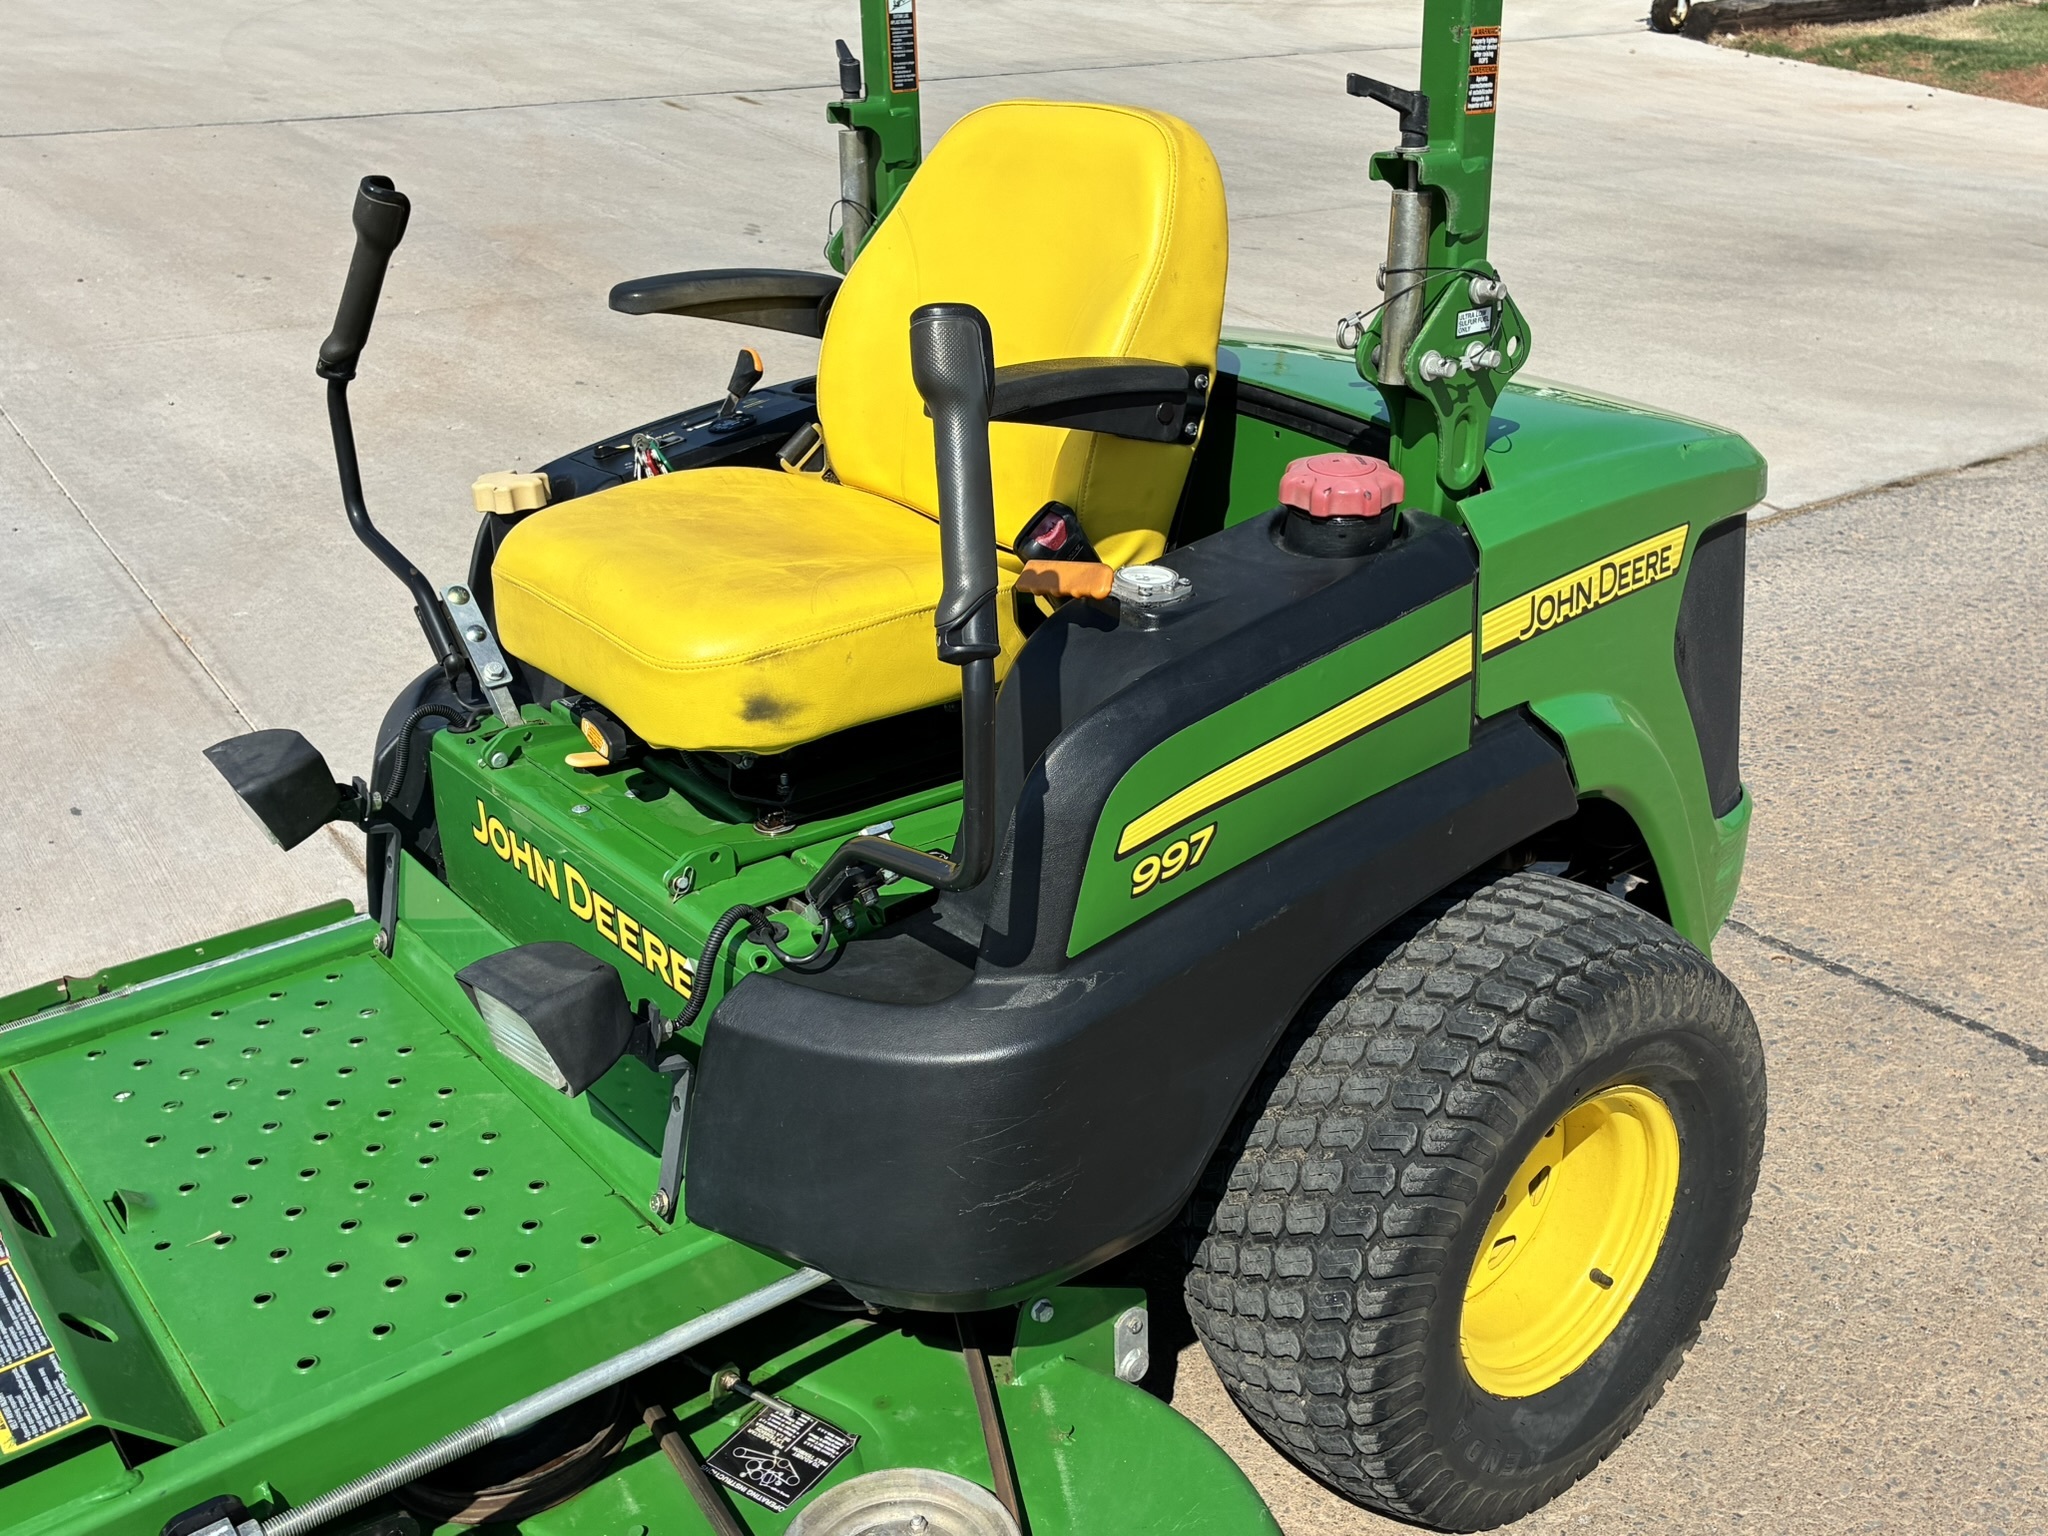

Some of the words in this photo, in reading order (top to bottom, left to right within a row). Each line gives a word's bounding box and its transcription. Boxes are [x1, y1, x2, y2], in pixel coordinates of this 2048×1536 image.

[1458, 326, 1471, 334] ONLY
[1459, 311, 1475, 321] ULTRA
[1475, 309, 1487, 318] LOW
[1519, 576, 1593, 638] JOHN
[1600, 544, 1673, 598] DEERE
[1131, 822, 1217, 897] 997
[471, 796, 561, 903] JOHN
[562, 858, 696, 1000] DEERE
[745, 1488, 786, 1513] OPERATING
